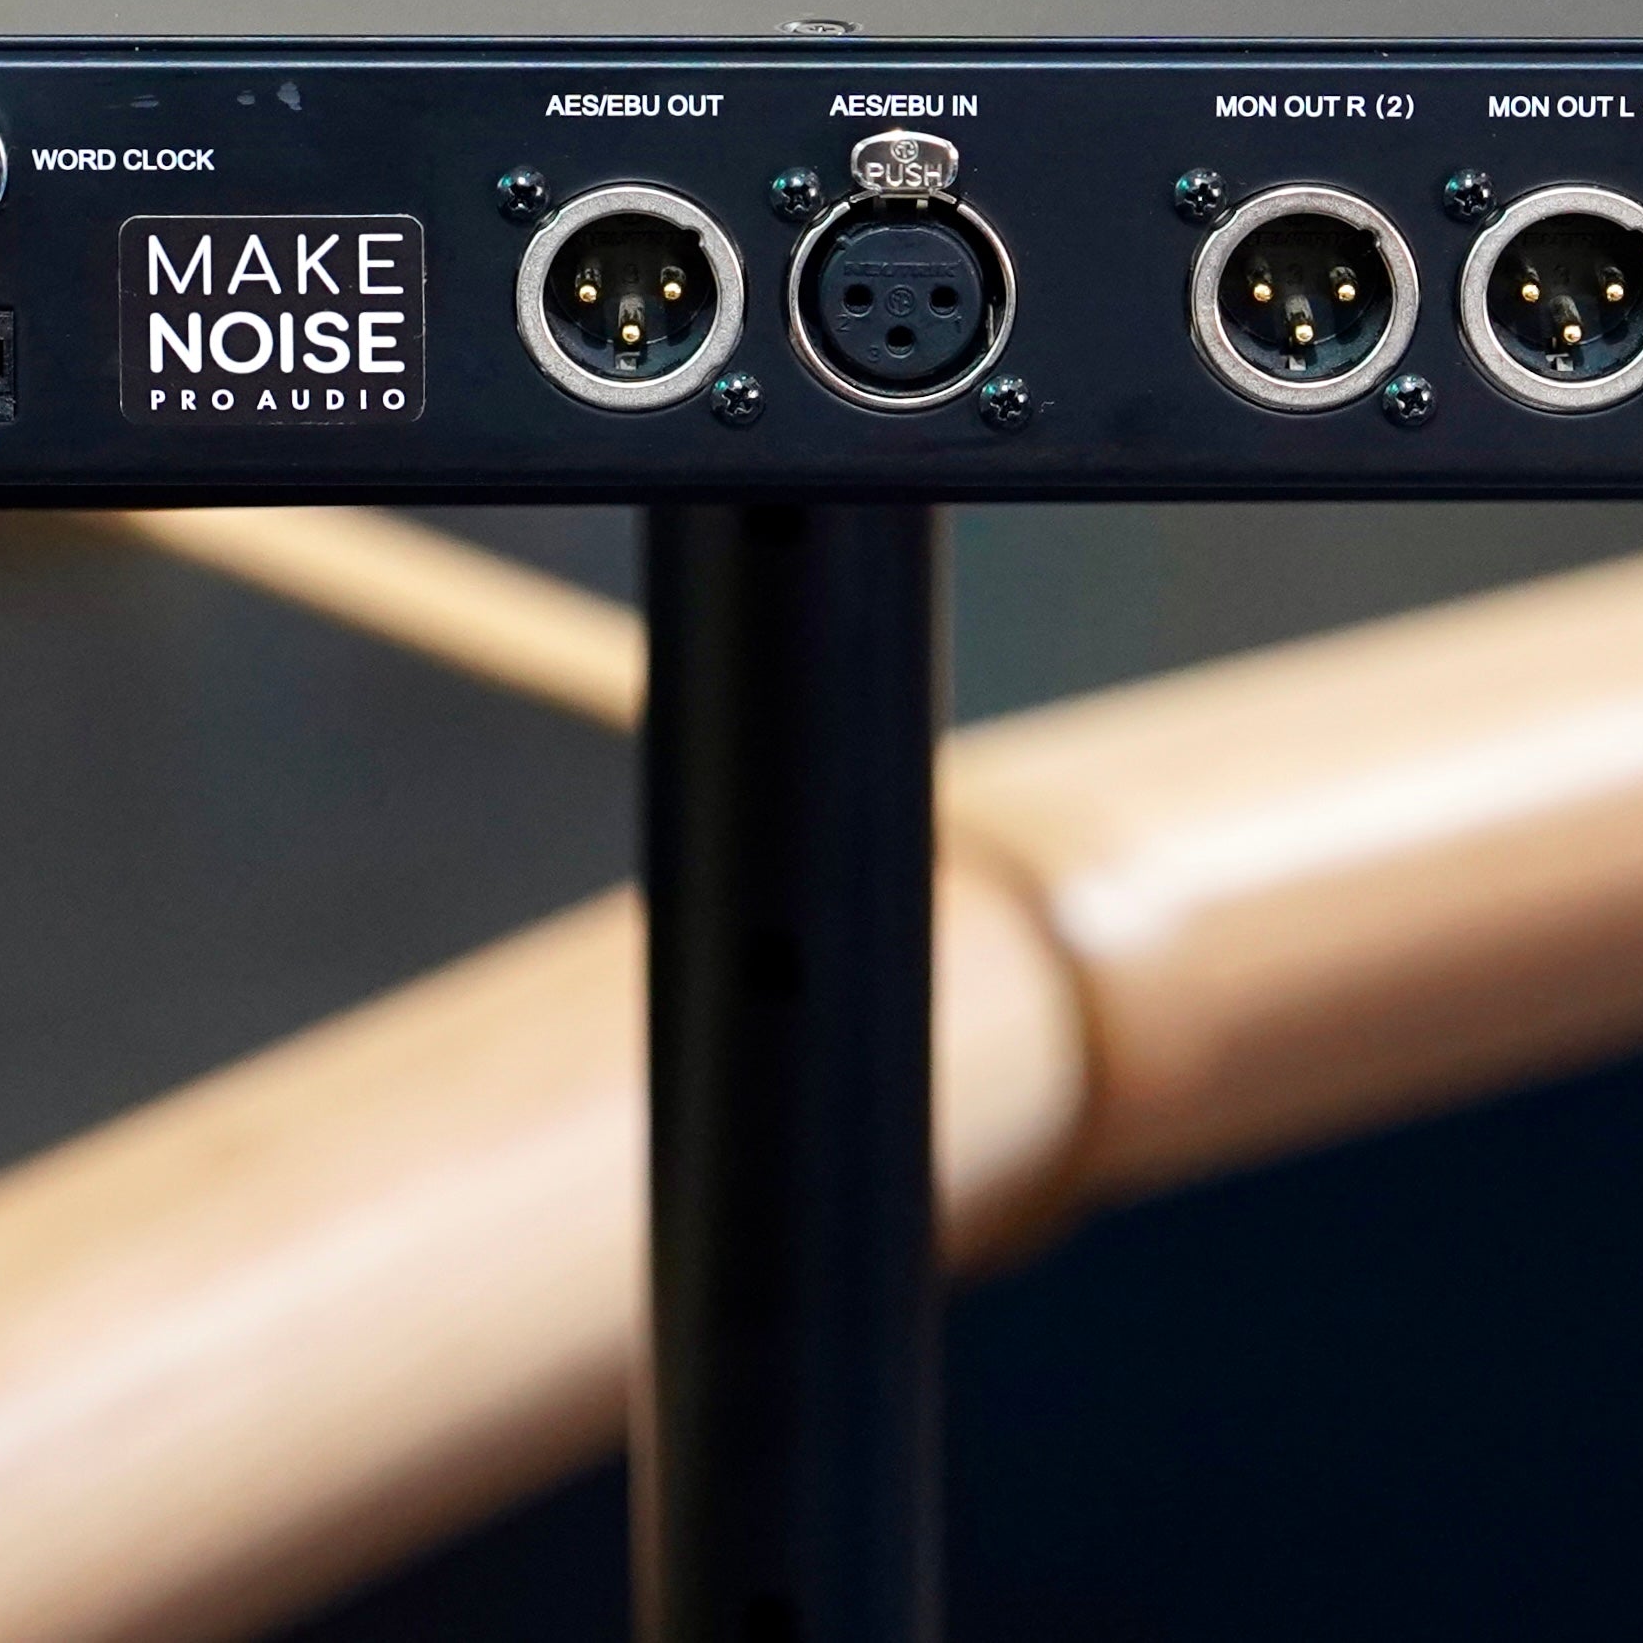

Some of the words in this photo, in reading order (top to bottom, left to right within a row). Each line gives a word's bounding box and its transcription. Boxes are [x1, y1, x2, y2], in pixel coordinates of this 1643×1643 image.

[545, 94, 661, 117] AES/EBU
[667, 94, 725, 117] OUT
[829, 94, 944, 117] AES/EBU
[952, 94, 978, 117] IN
[1215, 95, 1277, 118] MON
[1283, 95, 1341, 118] OUT
[1346, 95, 1367, 118] R
[1375, 93, 1415, 120] (2)
[1488, 95, 1550, 118] MON
[1556, 95, 1614, 118] OUT
[1619, 95, 1635, 118] L
[31, 148, 117, 171] WORD
[122, 148, 215, 171] CLOCK
[865, 162, 944, 188] PUSH
[148, 233, 404, 296] MAKE
[149, 310, 406, 375] NOISE
[150, 388, 235, 411] PRO
[256, 388, 406, 411] AUDIO
